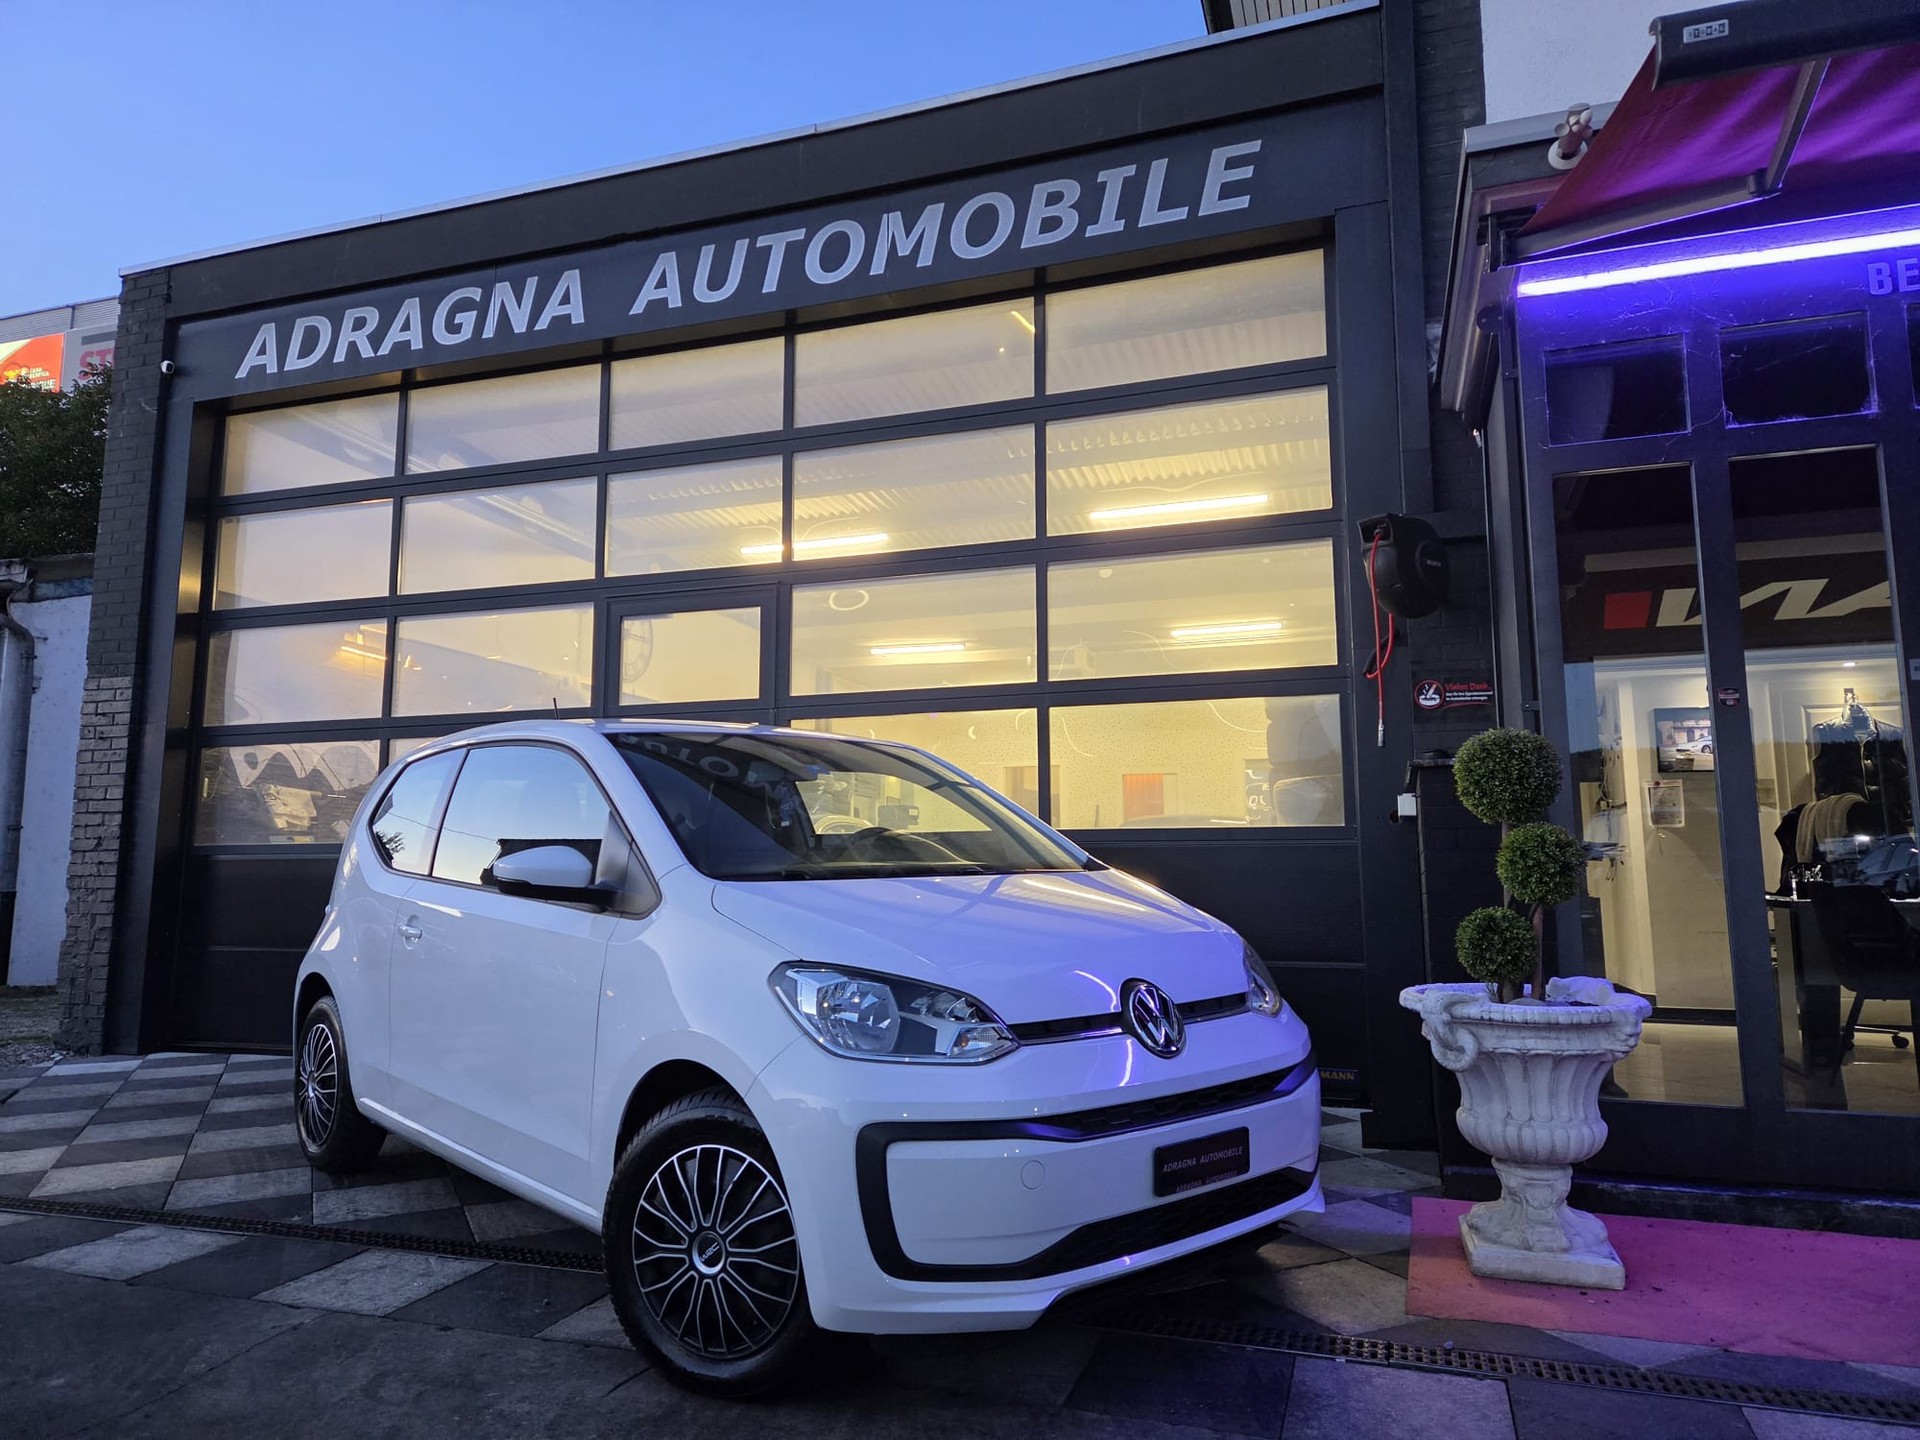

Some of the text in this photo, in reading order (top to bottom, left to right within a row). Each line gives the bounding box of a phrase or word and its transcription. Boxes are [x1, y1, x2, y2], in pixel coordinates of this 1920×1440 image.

[235, 140, 1262, 379] ADRAGNA AUTOMOBILE
[78, 348, 116, 380] ST
[1162, 1146, 1243, 1174] ADRAGNA AUTOMOBILE
